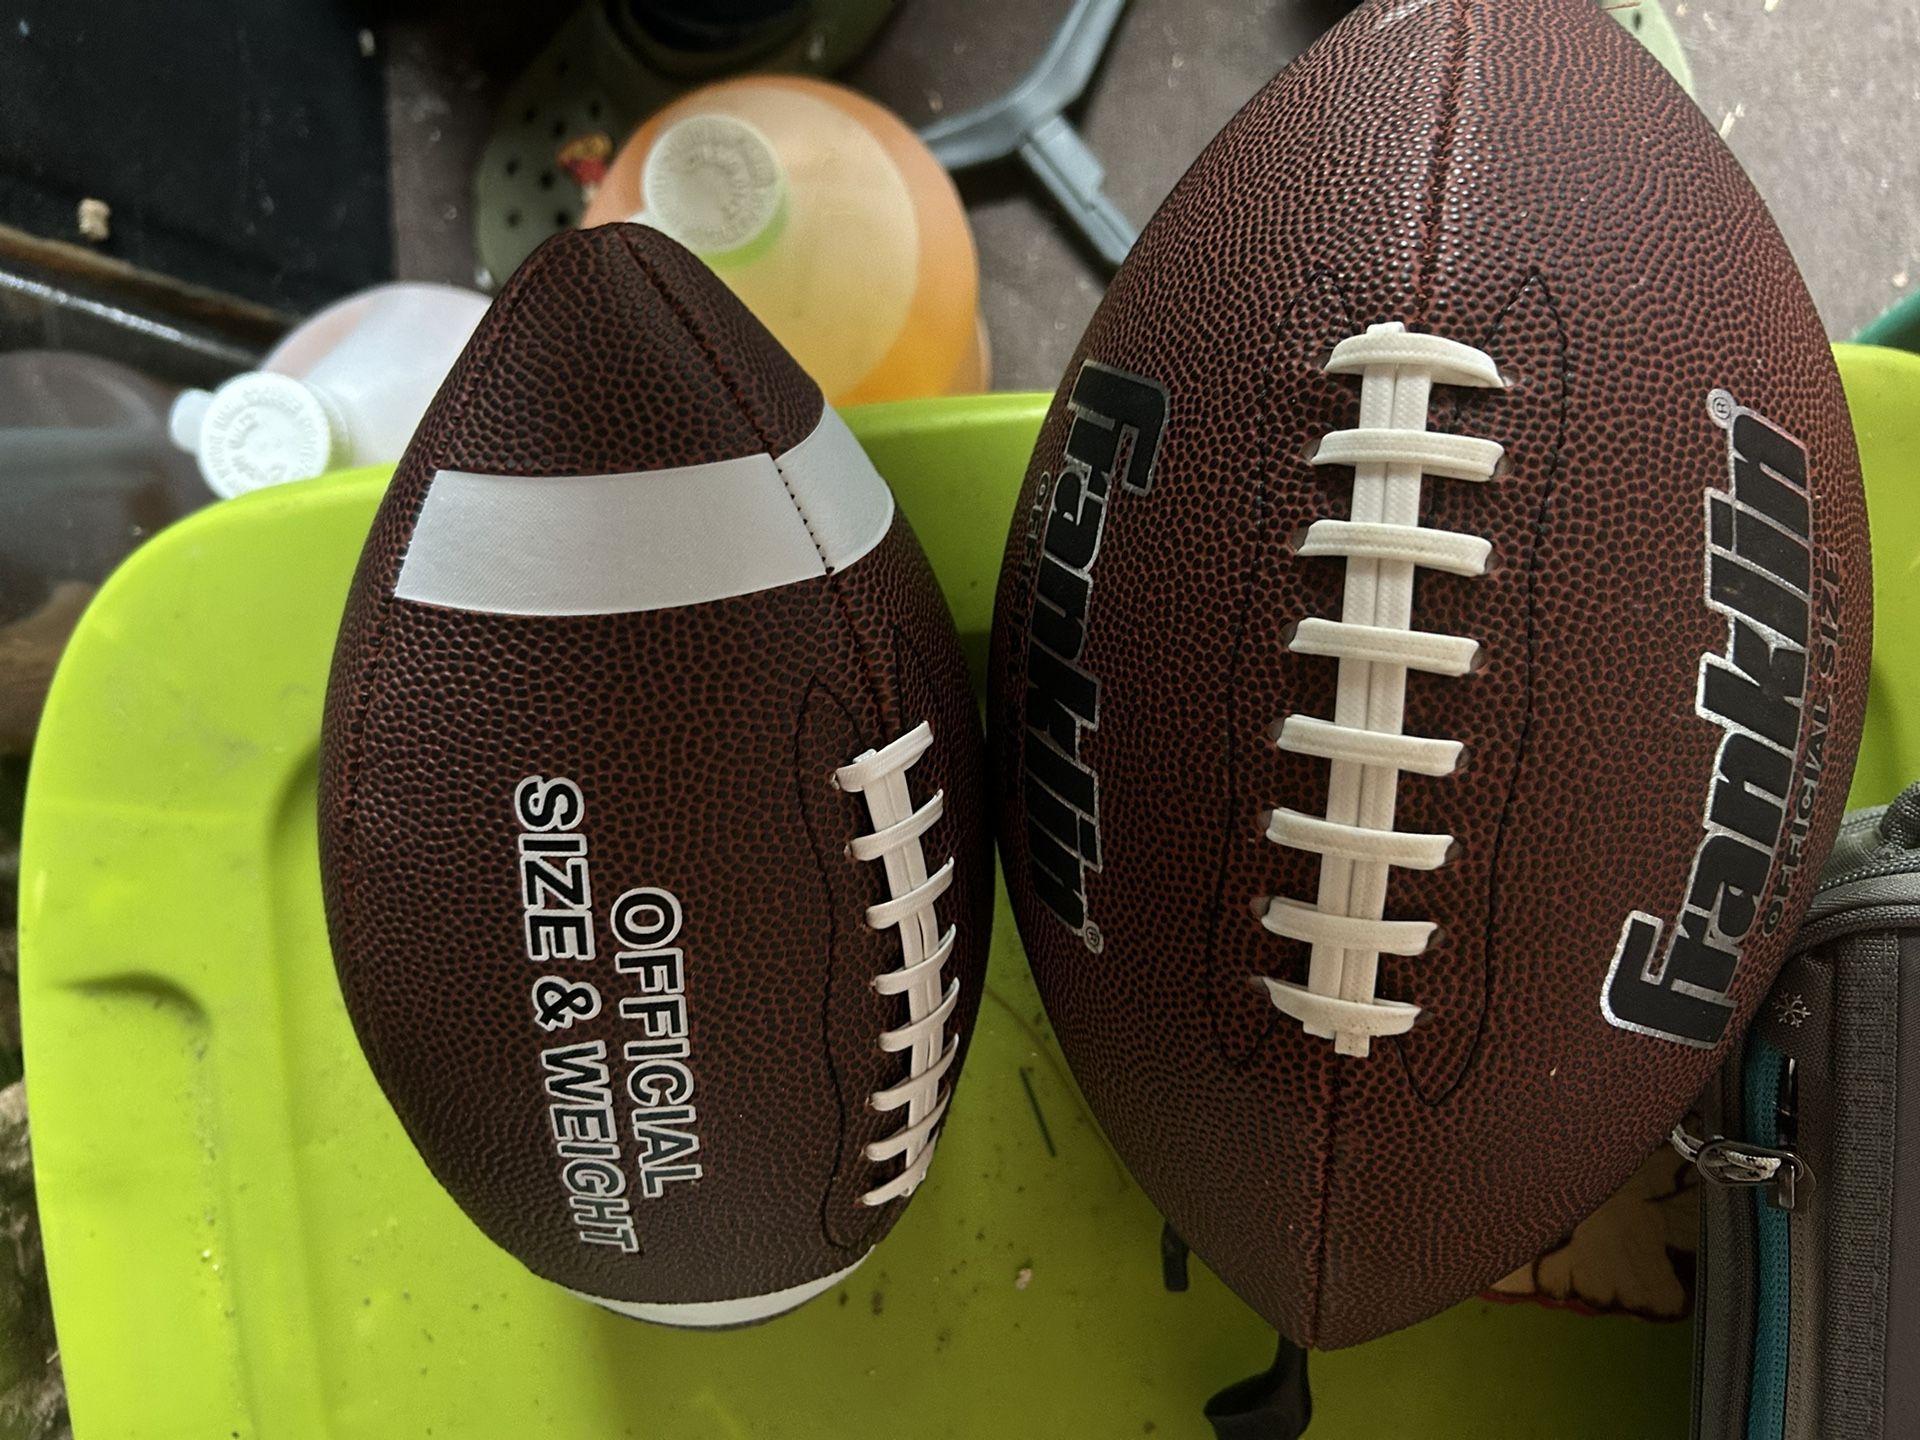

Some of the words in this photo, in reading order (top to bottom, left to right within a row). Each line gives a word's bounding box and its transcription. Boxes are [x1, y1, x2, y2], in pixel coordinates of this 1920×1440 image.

[1600, 404, 1814, 1050] Franklin
[1760, 694, 1835, 939] OFFICIAL
[1819, 549, 1842, 682] SIZE
[515, 776, 595, 961] SIZE
[532, 975, 602, 1031] &
[611, 887, 702, 1198] OFFICIAL
[541, 1040, 640, 1253] WEIGHT
